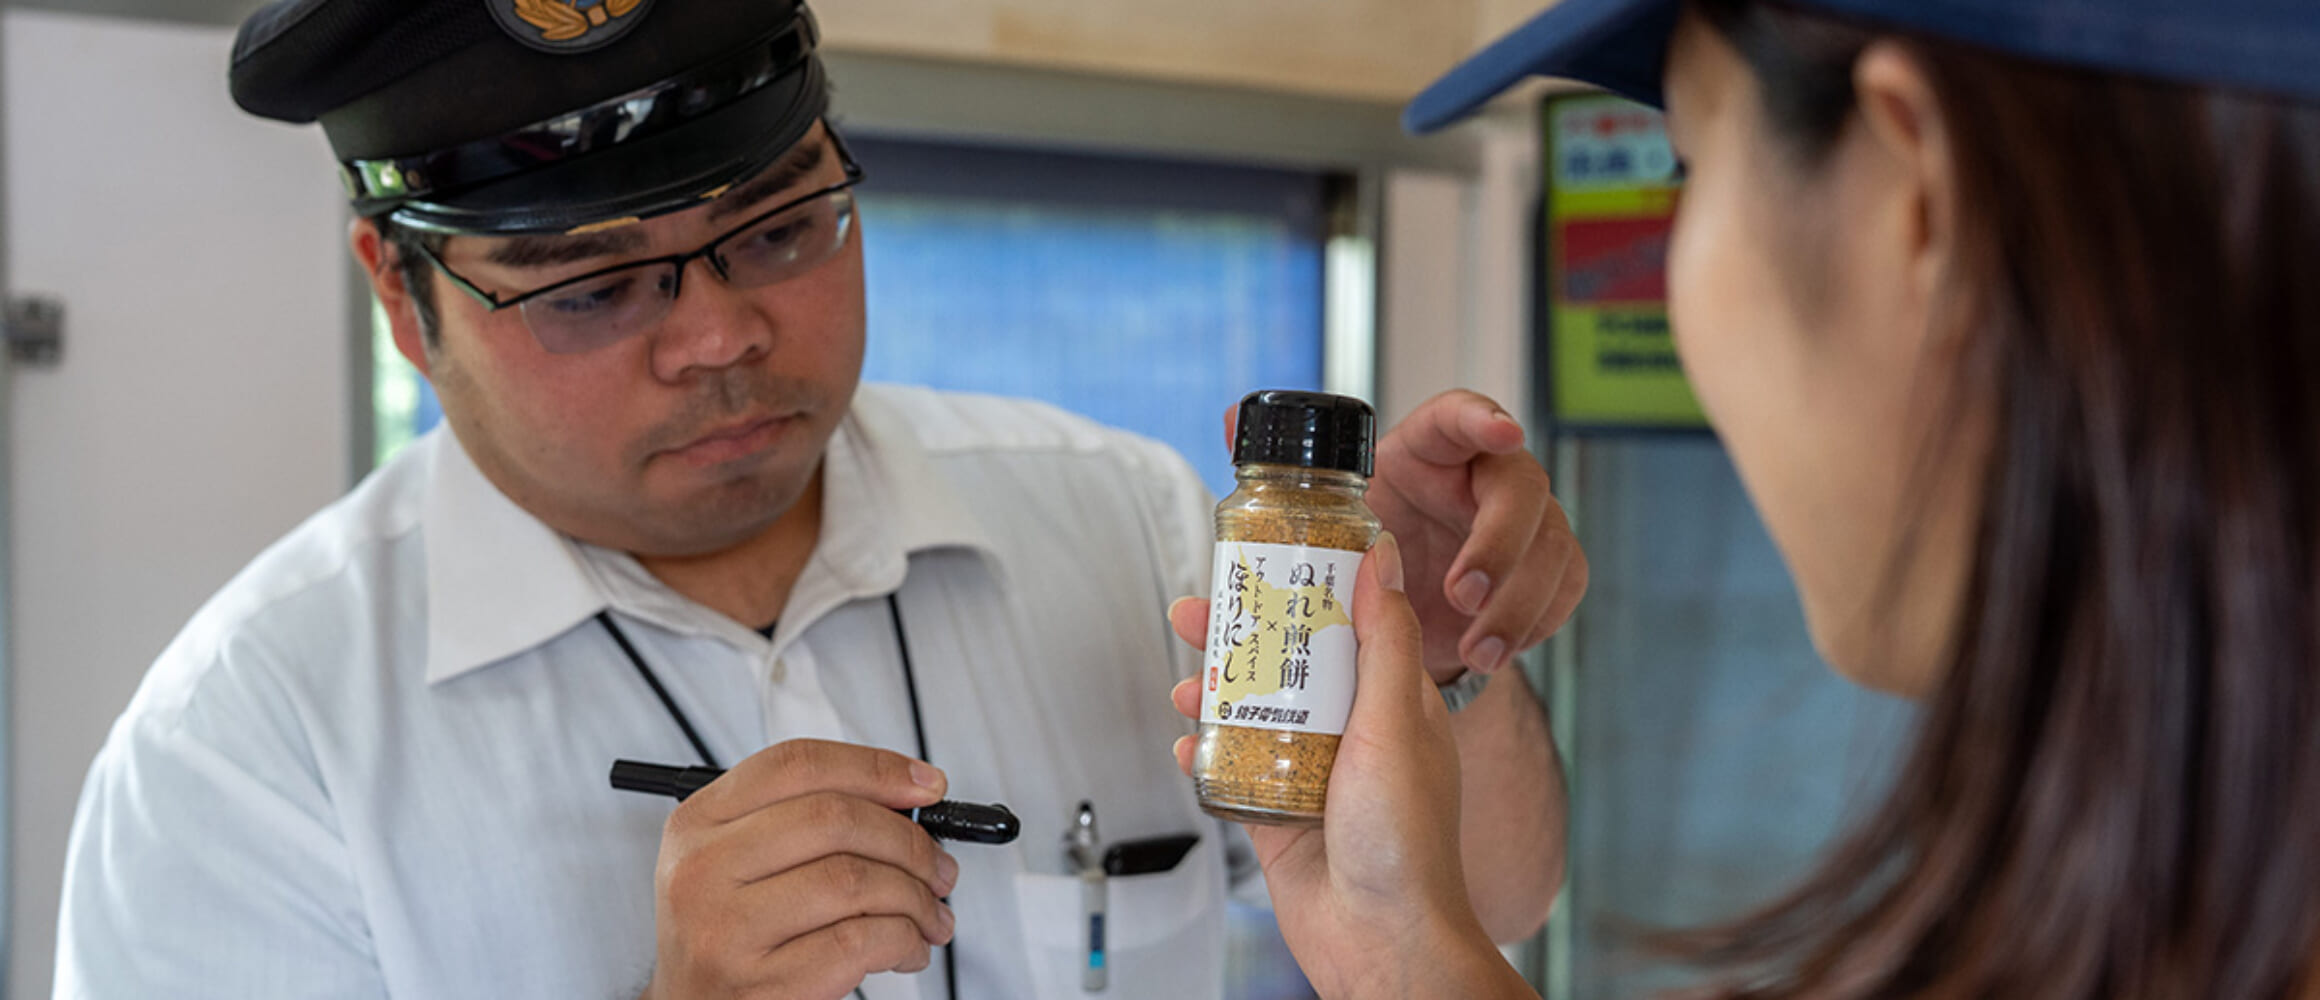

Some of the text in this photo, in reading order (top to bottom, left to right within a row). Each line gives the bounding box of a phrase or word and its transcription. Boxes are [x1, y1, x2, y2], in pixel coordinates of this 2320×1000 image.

[1223, 561, 1249, 683] ほりにし
[1279, 563, 1315, 690] ぬれ煎餅
